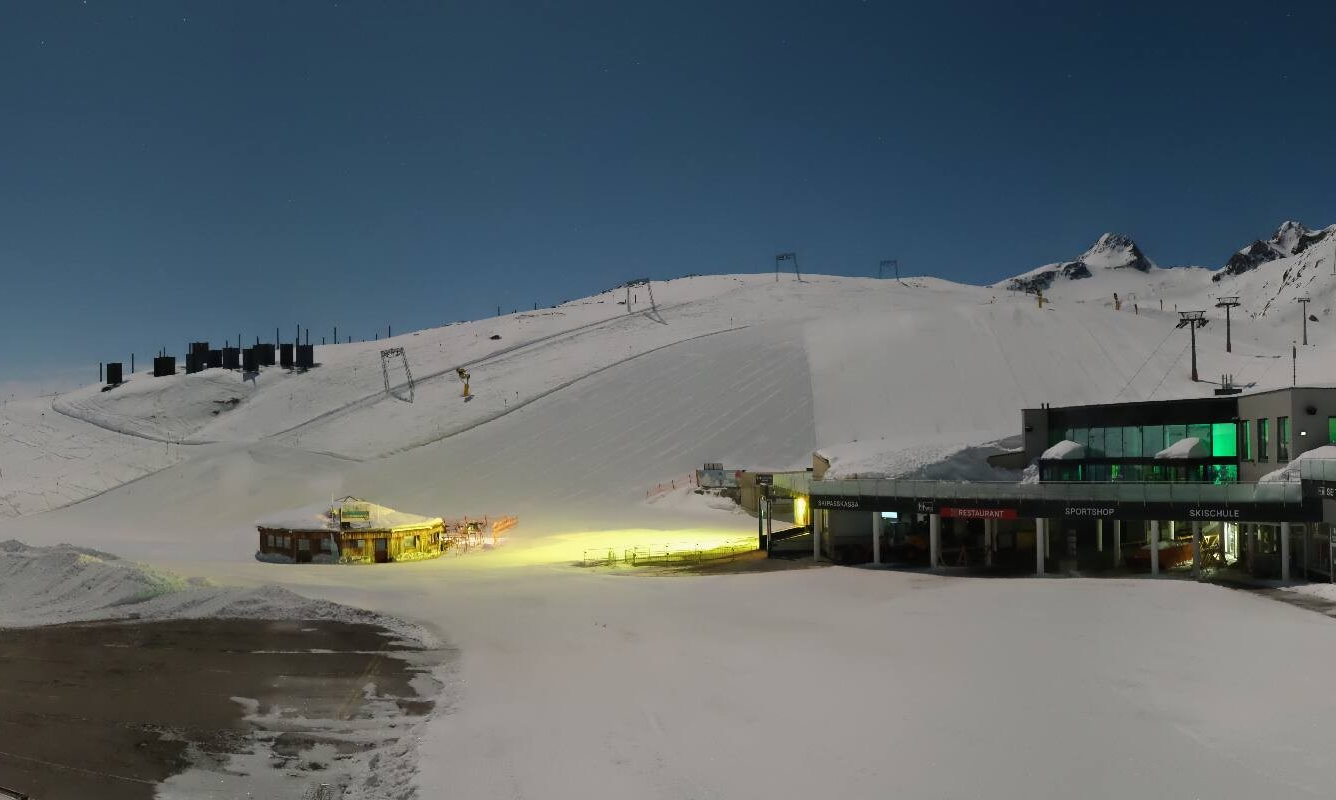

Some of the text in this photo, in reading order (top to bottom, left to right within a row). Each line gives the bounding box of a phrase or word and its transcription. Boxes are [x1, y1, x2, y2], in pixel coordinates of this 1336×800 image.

[958, 509, 1004, 518] RESTAURANT
[1065, 508, 1114, 516] SPORTSHOP
[1189, 509, 1239, 518] SKISCHULE
